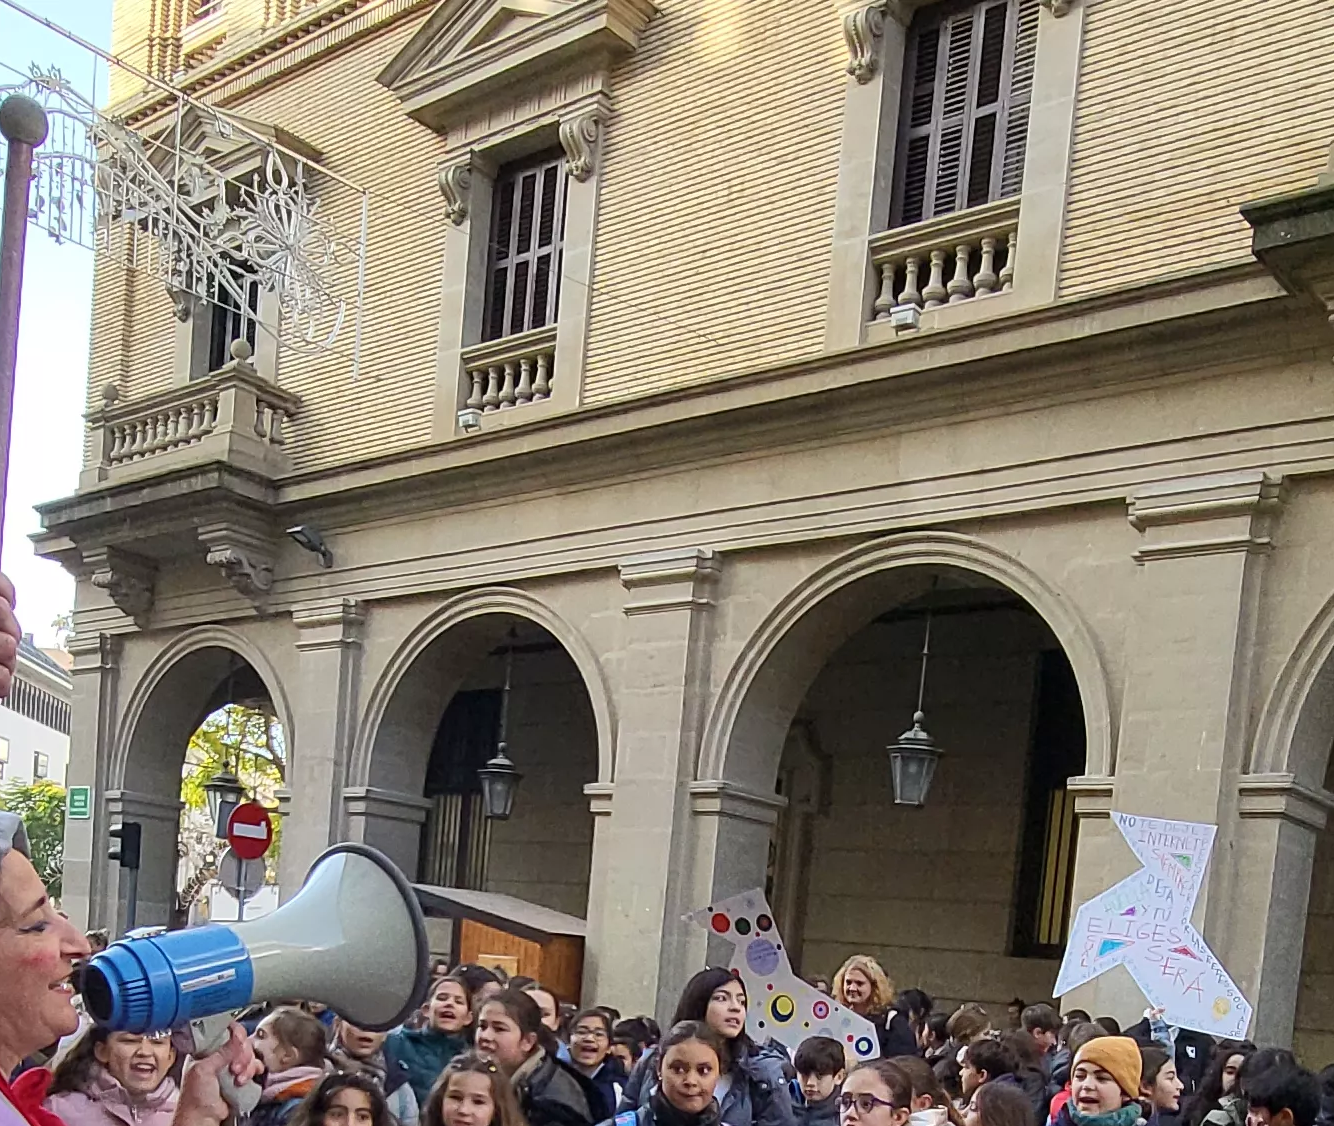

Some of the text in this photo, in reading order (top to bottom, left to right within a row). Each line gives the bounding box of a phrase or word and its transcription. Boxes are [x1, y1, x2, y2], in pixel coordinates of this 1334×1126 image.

[1119, 814, 1137, 828] NO
[1139, 820, 1156, 831] TE
[1137, 829, 1202, 852] INTERNET
[1147, 874, 1174, 904] DEJA
[1141, 904, 1151, 916] Y
[1087, 917, 1183, 944] ELIGES
[1144, 945, 1205, 1004] SERÁ
